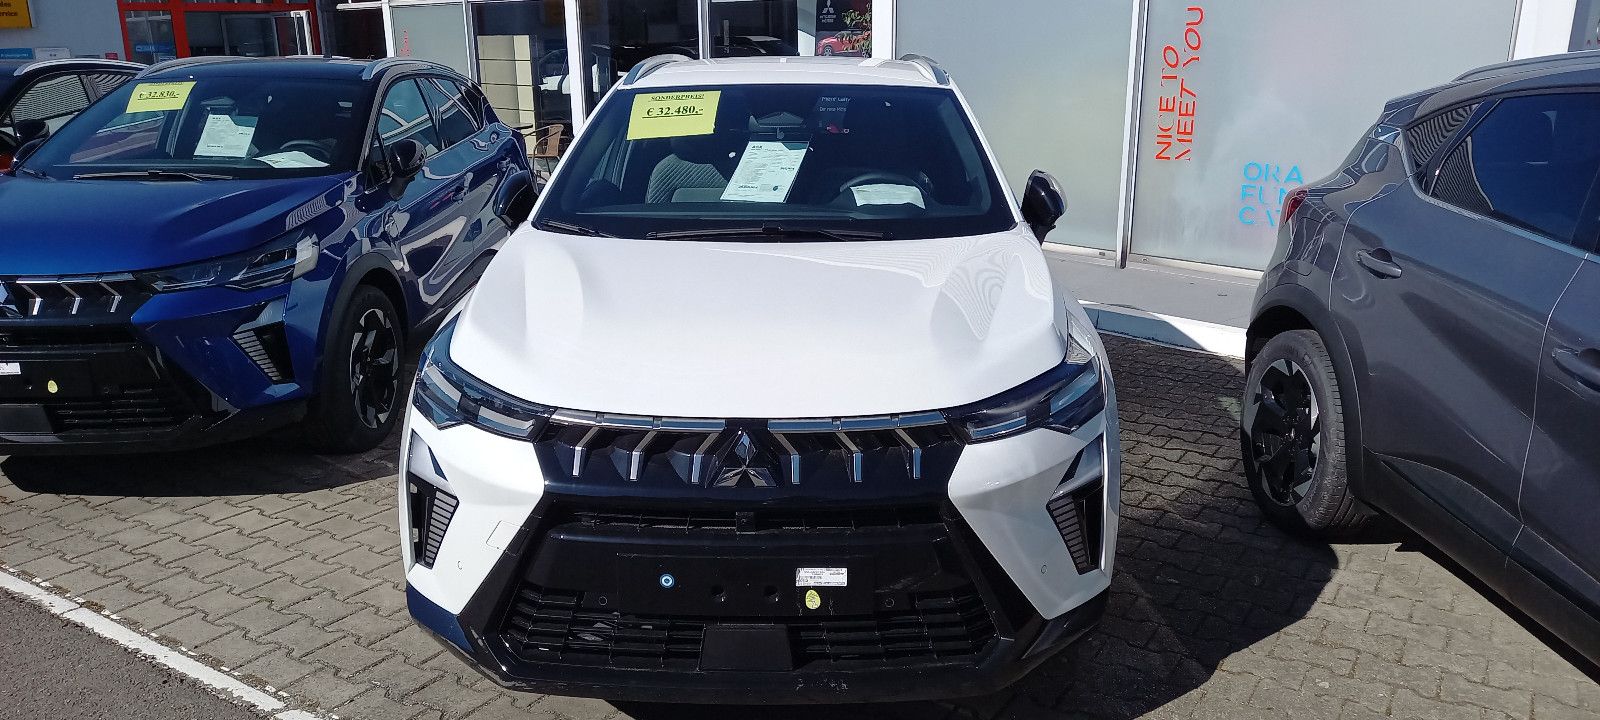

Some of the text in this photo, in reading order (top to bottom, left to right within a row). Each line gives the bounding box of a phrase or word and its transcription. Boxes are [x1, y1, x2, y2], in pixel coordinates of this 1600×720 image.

[646, 107, 655, 116] €
[1155, 45, 1179, 160] NICE TO
[1175, 7, 1204, 161] MEET YOU
[1243, 161, 1304, 184] ORA
